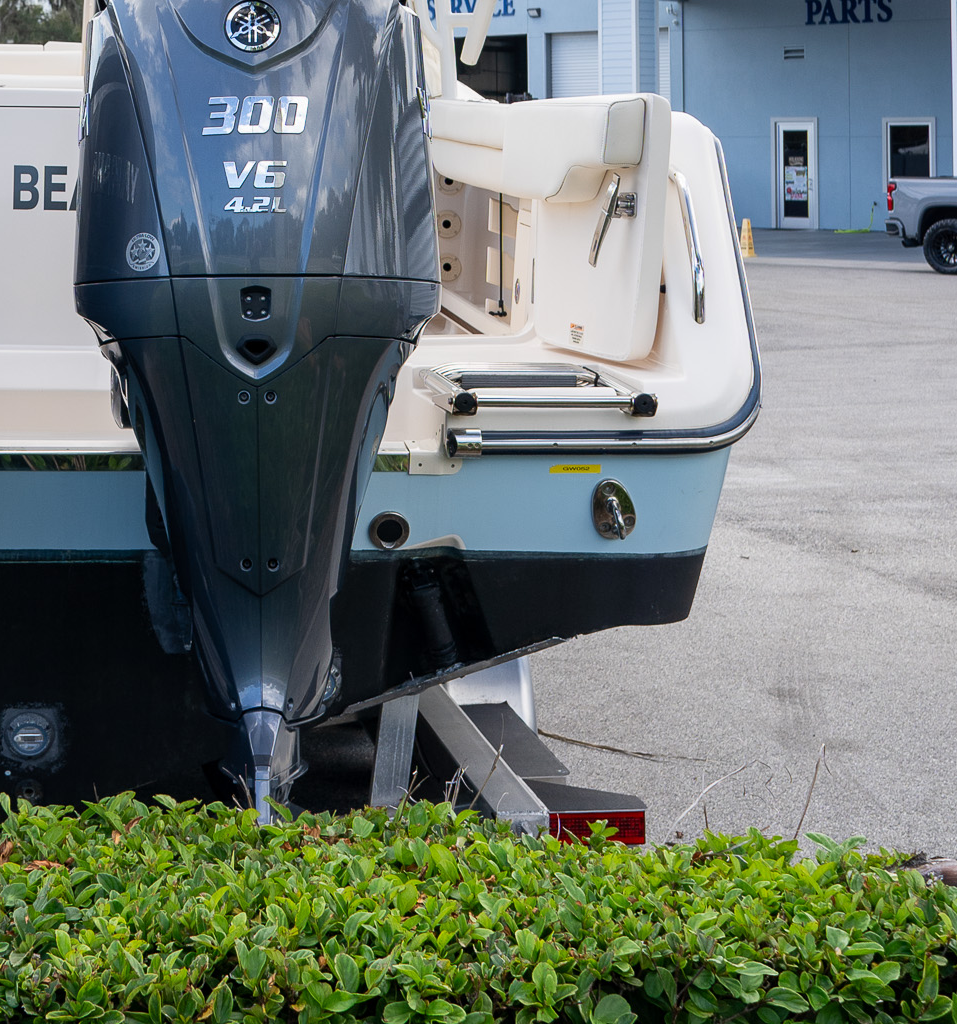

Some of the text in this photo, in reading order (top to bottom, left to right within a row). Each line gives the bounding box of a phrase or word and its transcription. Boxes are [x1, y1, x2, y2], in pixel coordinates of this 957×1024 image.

[202, 96, 308, 135] 300
[223, 160, 287, 189] V6
[224, 196, 287, 213] 4.2L
